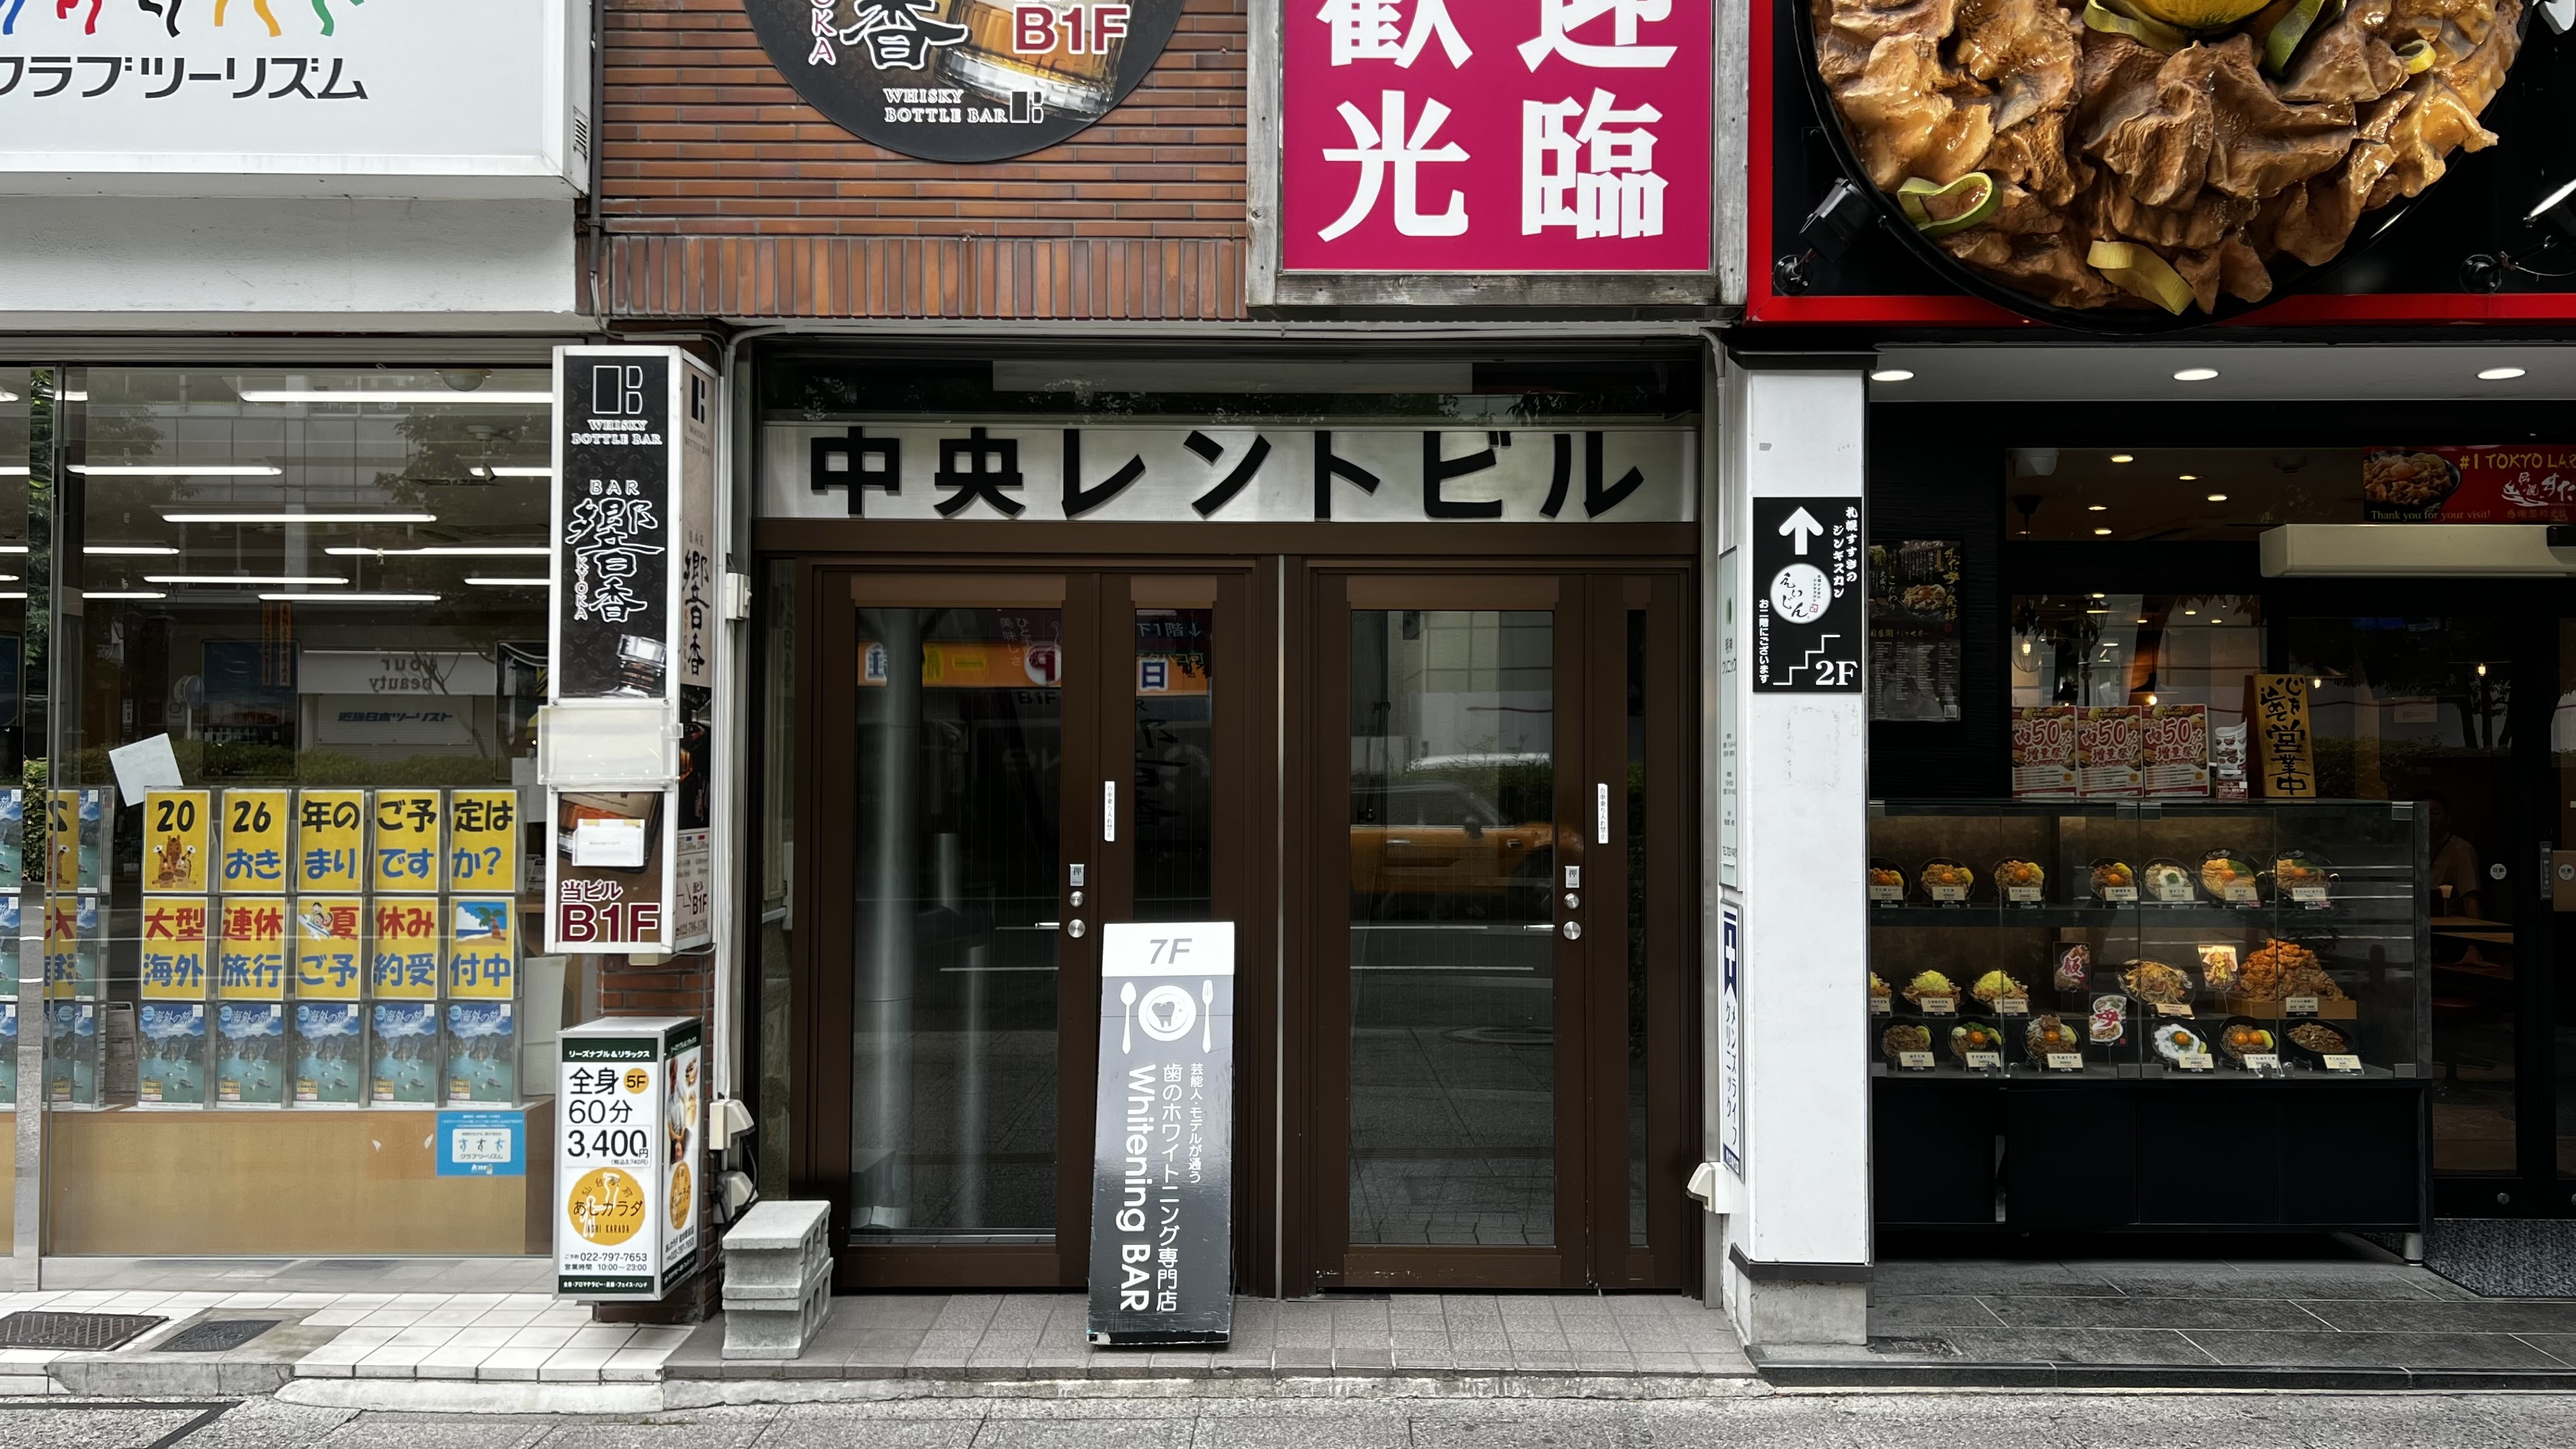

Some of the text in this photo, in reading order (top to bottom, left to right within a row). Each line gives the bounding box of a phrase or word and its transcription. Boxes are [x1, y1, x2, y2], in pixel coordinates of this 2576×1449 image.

[808, 0, 838, 65] KA
[1013, 4, 1130, 54] B1F
[883, 88, 964, 104] WHISKY
[885, 107, 1008, 123] BOTTLE BAR
[1317, 87, 1669, 243] 光臨
[587, 419, 648, 431] WHISKY
[571, 433, 663, 445] BOTTLE BAR
[811, 426, 1644, 519] 中央レントビル
[2459, 453, 2479, 469] #1
[2485, 453, 2543, 469] TOKYO
[590, 479, 640, 496] BAR
[2371, 510, 2490, 523] Thank you for your visit!
[689, 530, 705, 547] BAR
[1833, 525, 1844, 598] ジンギスカン
[574, 556, 589, 621] KYOKA
[1815, 660, 1858, 686] 2F
[157, 799, 513, 832] 20 26 年の ご予 定は
[225, 847, 502, 879] おき まり です か?
[560, 879, 624, 901] 当ビル
[692, 893, 708, 916] B1F
[145, 906, 435, 941] 大型 連休 夏 休み
[560, 902, 661, 943] B1F
[1150, 938, 1193, 964] 7F
[143, 952, 511, 988] 海外 旅行 ご予 約受 付中
[569, 1067, 618, 1095] 全身
[626, 1075, 646, 1088] 5F
[569, 1099, 632, 1124] 60分
[1188, 1062, 1204, 1184] 芸能人・モデルが通う
[567, 1129, 648, 1159] 3,400円
[1116, 1064, 1156, 1312] Whitening BAR
[1156, 1063, 1183, 1313] 歯のホワイトニング専門店
[574, 1200, 643, 1217] あしカラダ
[606, 1225, 630, 1233] KARADA
[580, 1252, 647, 1262] 022-797-7653
